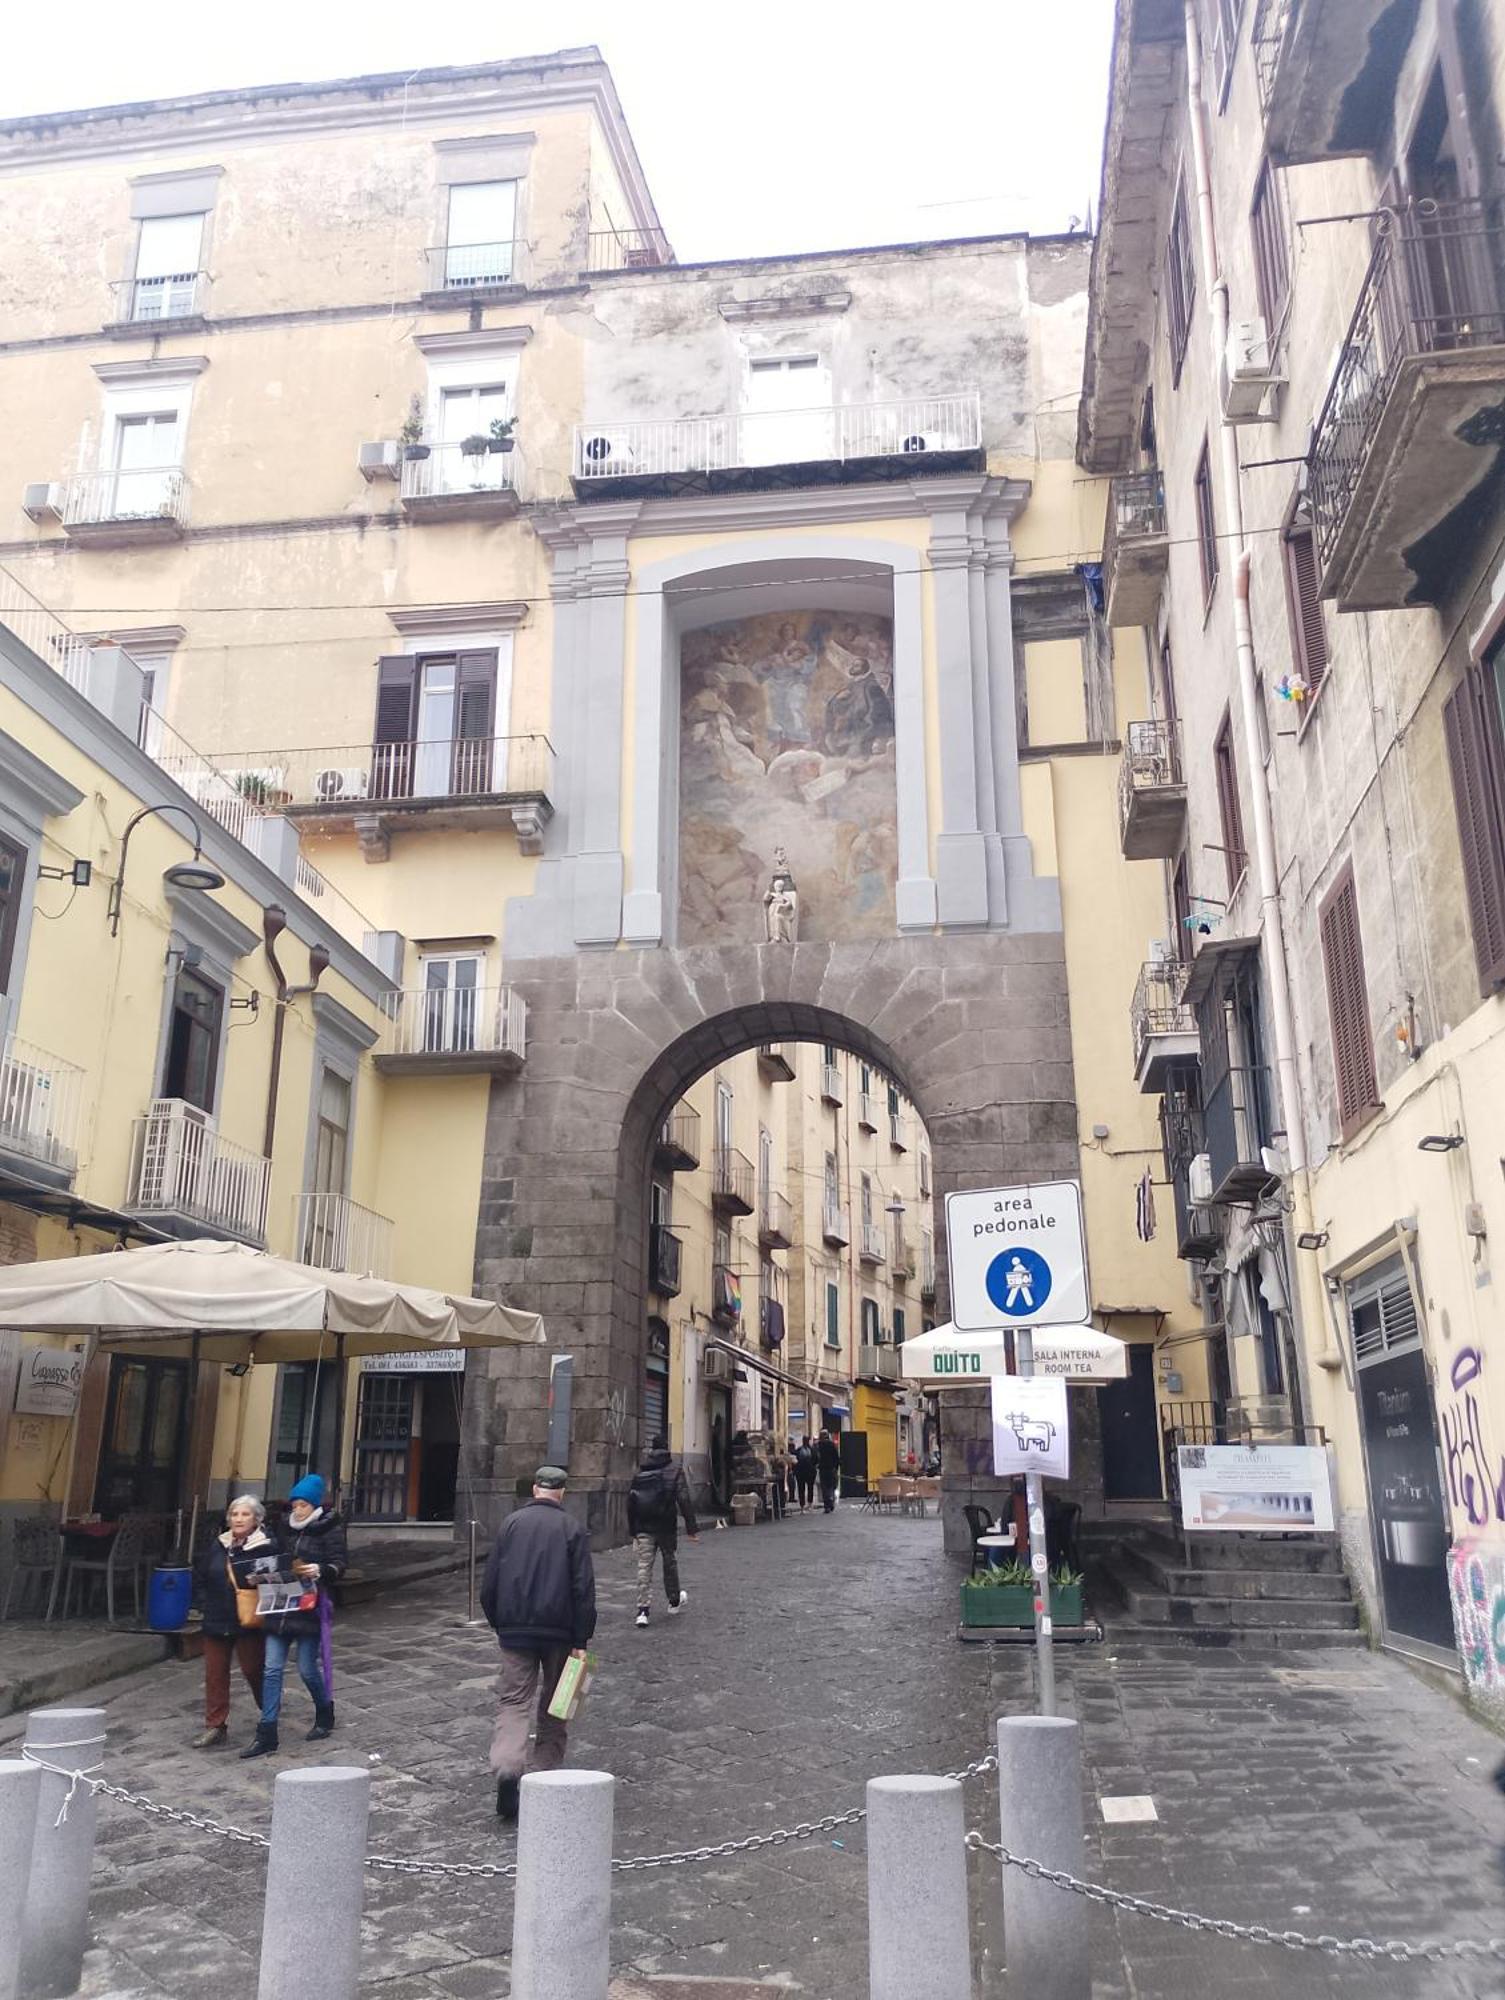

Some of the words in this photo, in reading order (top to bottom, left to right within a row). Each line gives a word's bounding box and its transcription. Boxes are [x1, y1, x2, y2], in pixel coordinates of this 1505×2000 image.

[994, 1198, 1033, 1212] area
[973, 1214, 1056, 1237] pedonale
[1034, 1351, 1057, 1361] SALA
[1060, 1350, 1100, 1360] INTERNA
[1045, 1363, 1071, 1373] ROOM
[1074, 1363, 1092, 1373] TEA
